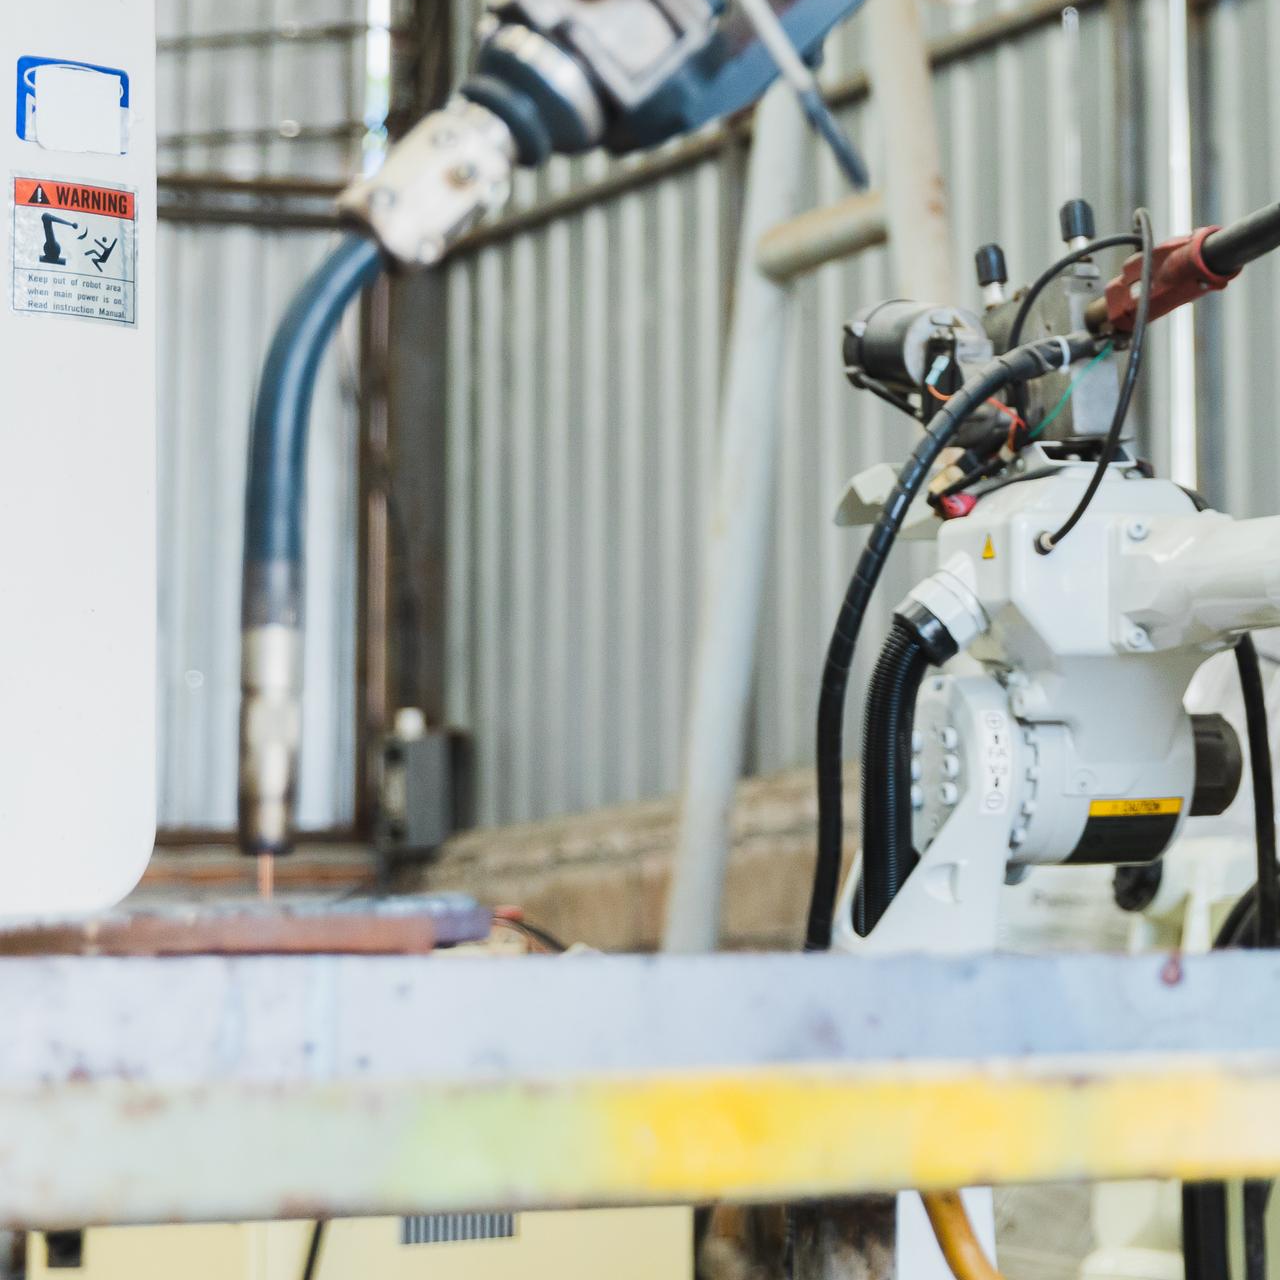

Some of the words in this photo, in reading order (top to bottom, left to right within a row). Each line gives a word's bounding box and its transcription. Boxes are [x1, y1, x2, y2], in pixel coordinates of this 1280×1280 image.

[56, 185, 129, 216] WARNING
[27, 273, 49, 284] Keep
[53, 276, 66, 286] out
[70, 278, 78, 287] of
[82, 280, 102, 290] robot
[105, 284, 122, 293] area
[27, 287, 49, 297] when
[53, 289, 73, 299] main
[77, 292, 99, 303] power
[103, 294, 110, 304] is
[27, 299, 48, 310] Read
[53, 301, 95, 315] instruction
